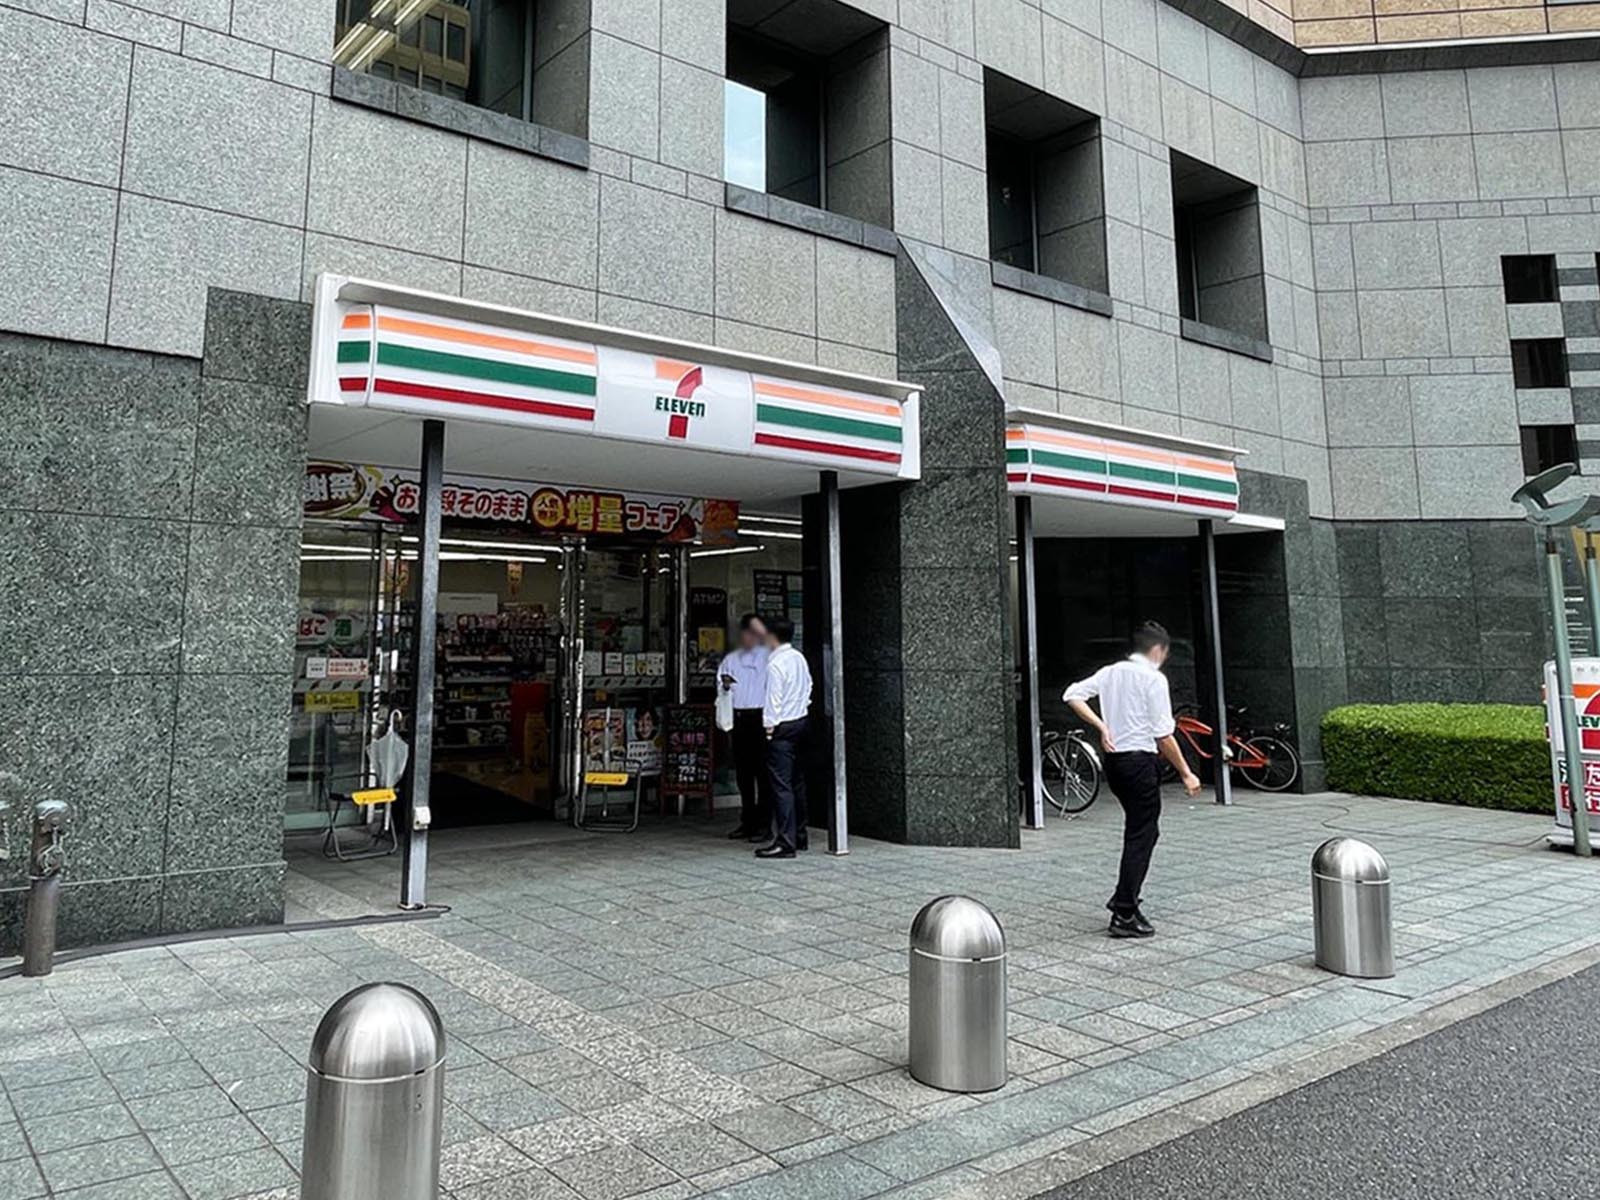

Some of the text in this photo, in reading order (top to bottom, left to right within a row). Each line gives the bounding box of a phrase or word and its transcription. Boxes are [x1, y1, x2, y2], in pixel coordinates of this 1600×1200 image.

[397, 484, 527, 517] お段そのまま
[1575, 715, 1600, 728] LEV
